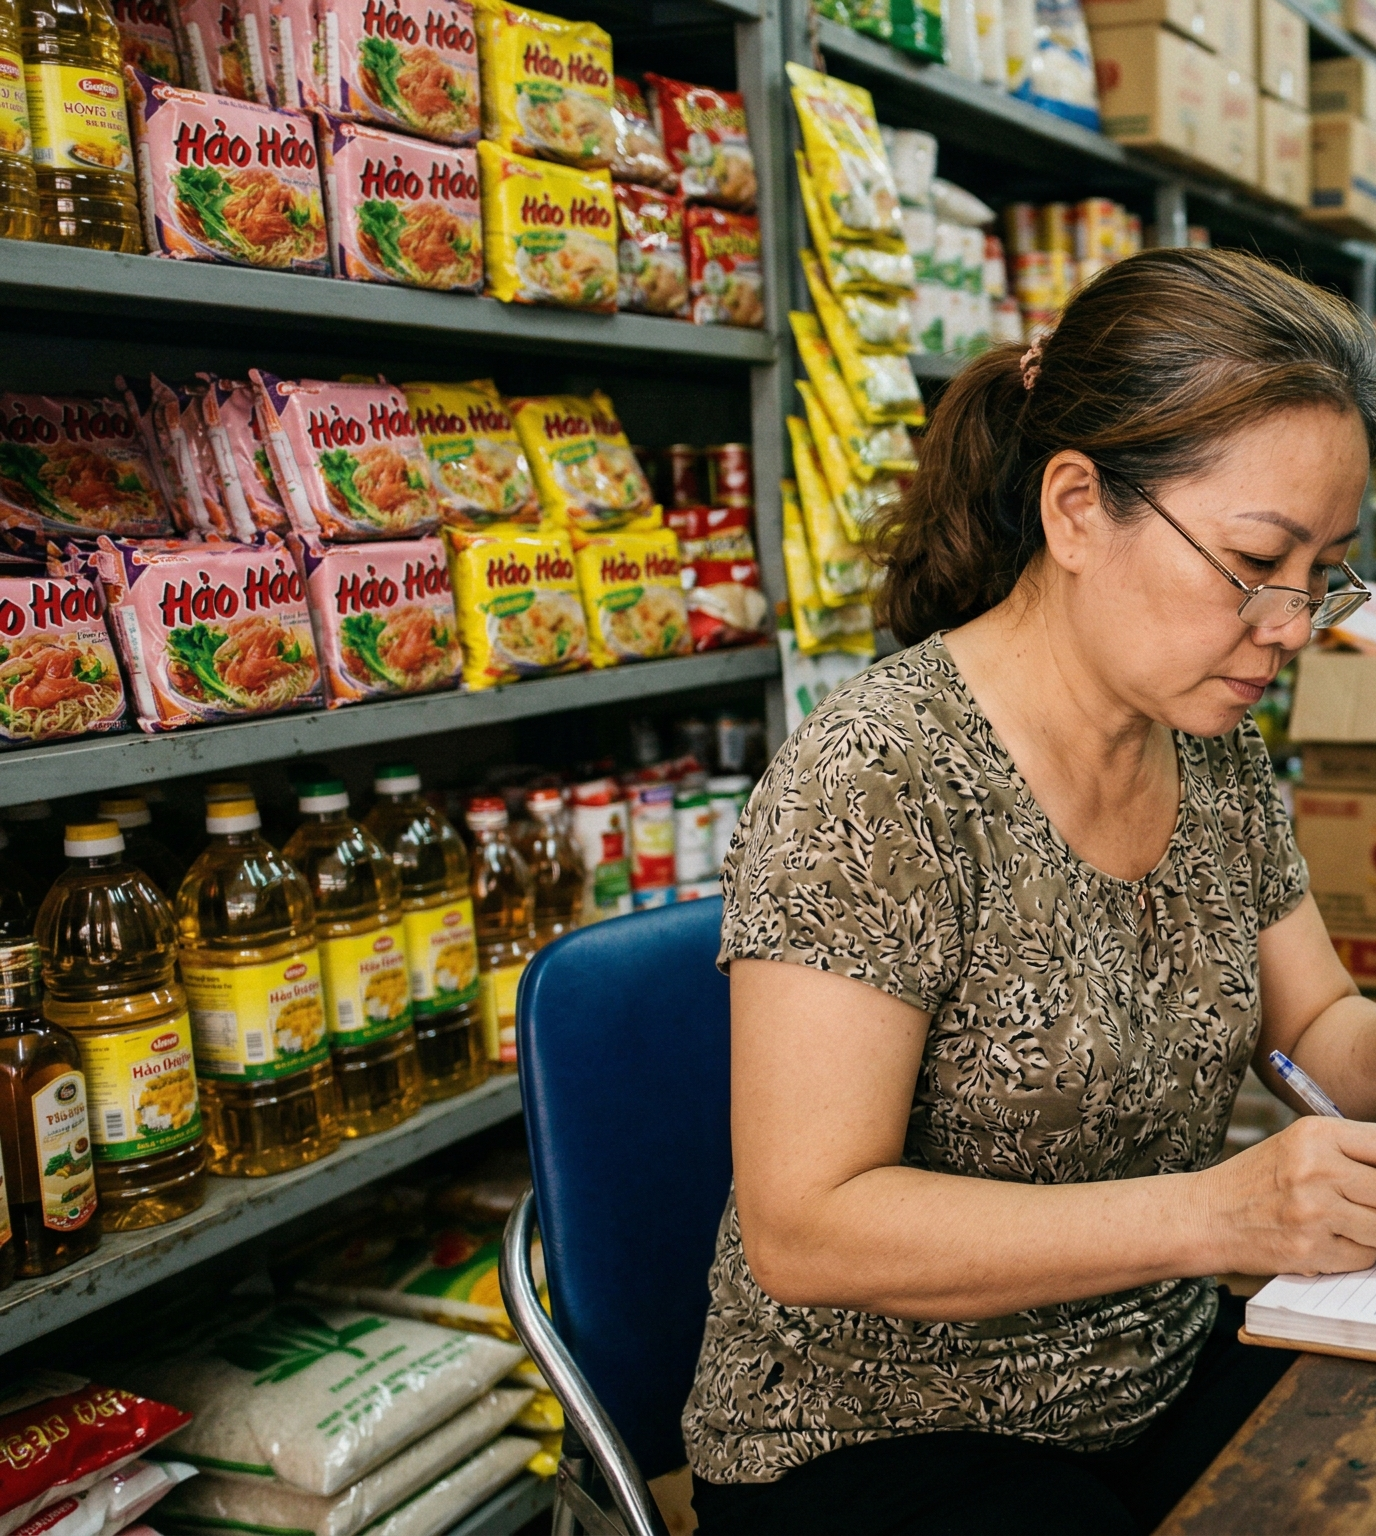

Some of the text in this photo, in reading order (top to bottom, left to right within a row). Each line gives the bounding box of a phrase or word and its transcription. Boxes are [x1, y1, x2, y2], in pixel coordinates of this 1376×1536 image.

[425, 9, 475, 54] Hảo
[523, 43, 564, 81] Hảo
[173, 118, 316, 170] Hảo Hảo
[360, 155, 479, 201] Hảo Hảo
[521, 192, 612, 229] Hảo Hảo
[307, 404, 367, 449] Hảo
[334, 564, 399, 615] Hảo
[486, 547, 574, 588] Hảo Hảo
[29, 575, 104, 630] Hảo
[158, 558, 305, 628] Hảo Hảo
